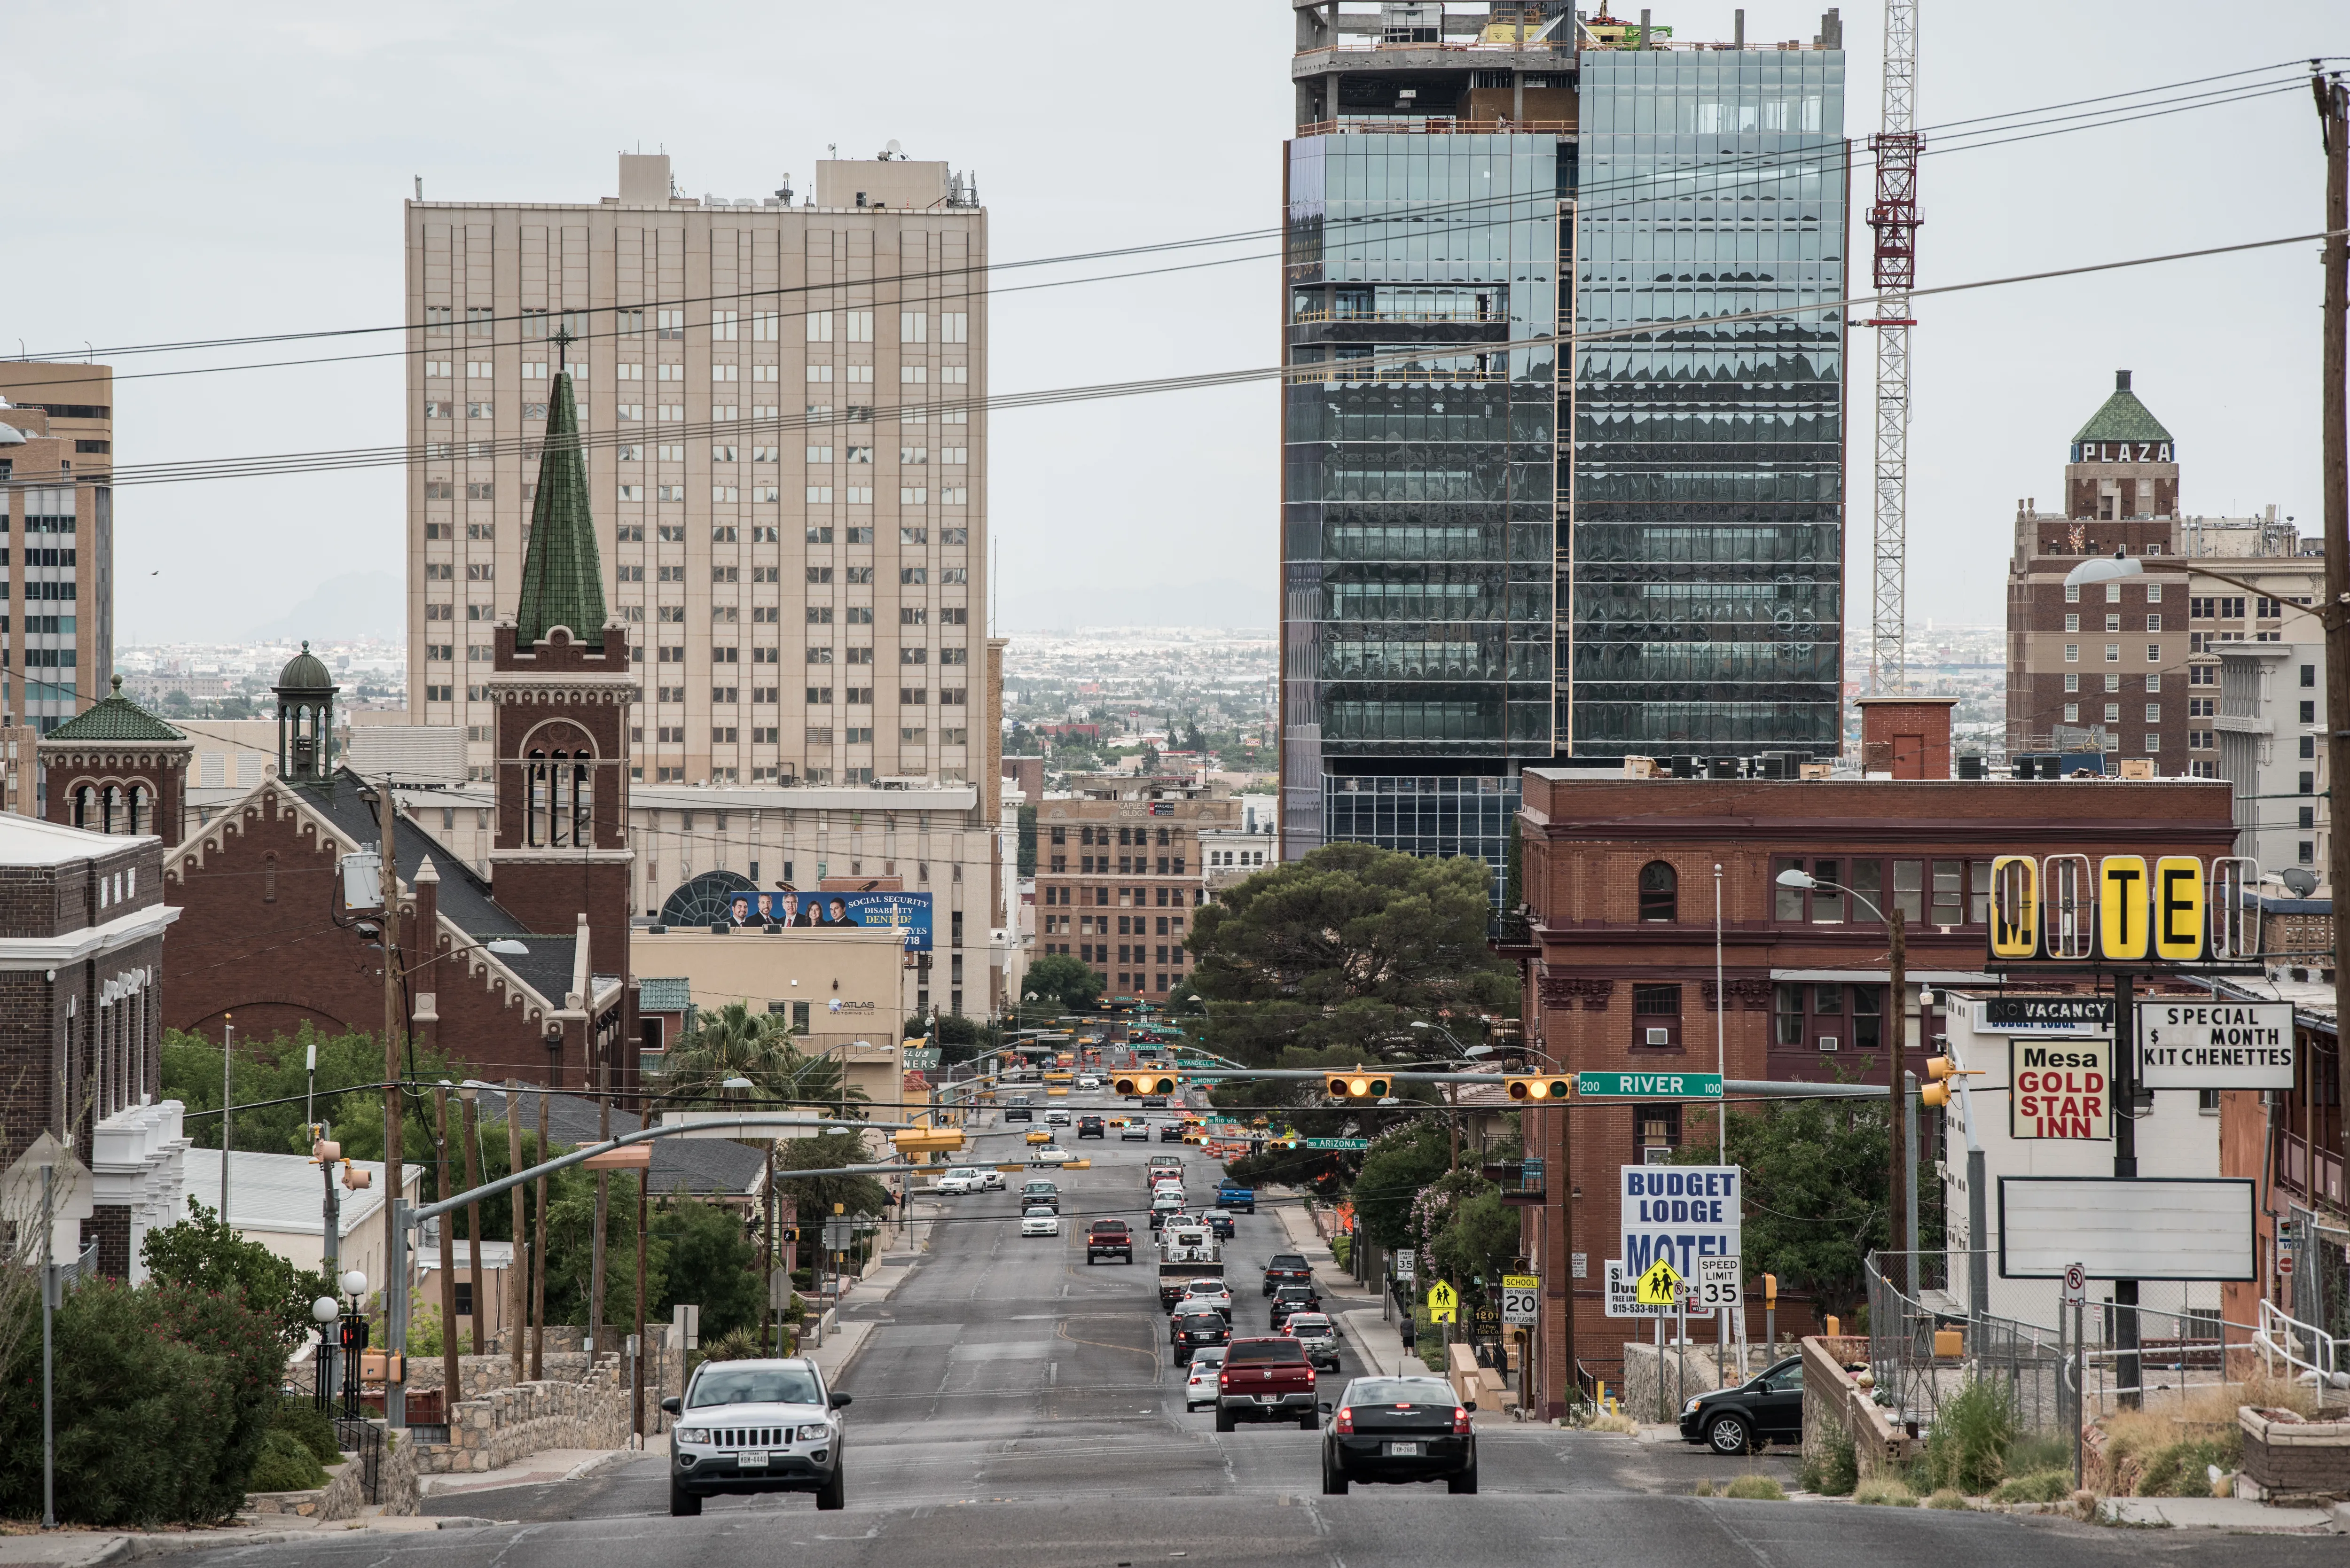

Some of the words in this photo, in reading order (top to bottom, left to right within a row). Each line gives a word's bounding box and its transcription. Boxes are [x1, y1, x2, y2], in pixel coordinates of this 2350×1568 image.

[2083, 443, 2171, 462] PLAZA
[848, 896, 882, 908] SOCIAL
[884, 896, 929, 908] SECURITY
[865, 915, 912, 924] DENID?
[2024, 1003, 2107, 1017] VACANCY
[2168, 1008, 2259, 1025] SPECIAL
[2151, 1029, 2159, 1045] $
[2210, 1028, 2279, 1045] MONTH
[2024, 1048, 2098, 1068] Mesa
[1581, 1081, 1600, 1092] 200
[1620, 1076, 1684, 1093] RIVER
[1705, 1084, 1721, 1093] 100
[2018, 1071, 2104, 1093] GOLD
[2021, 1095, 2103, 1117] STAR
[2037, 1117, 2091, 1138] INN
[1319, 1139, 1356, 1148] ARIZONA
[1628, 1173, 1735, 1196] BUDGET
[1640, 1200, 1723, 1223] LODGE
[1702, 1261, 1738, 1269] SPEED
[1706, 1272, 1733, 1280] LIMIT
[1704, 1283, 1737, 1303] 35
[1505, 1295, 1535, 1312] 20
[1613, 1304, 1667, 1313] 915-533-681
[1475, 1311, 1499, 1320] 1201
